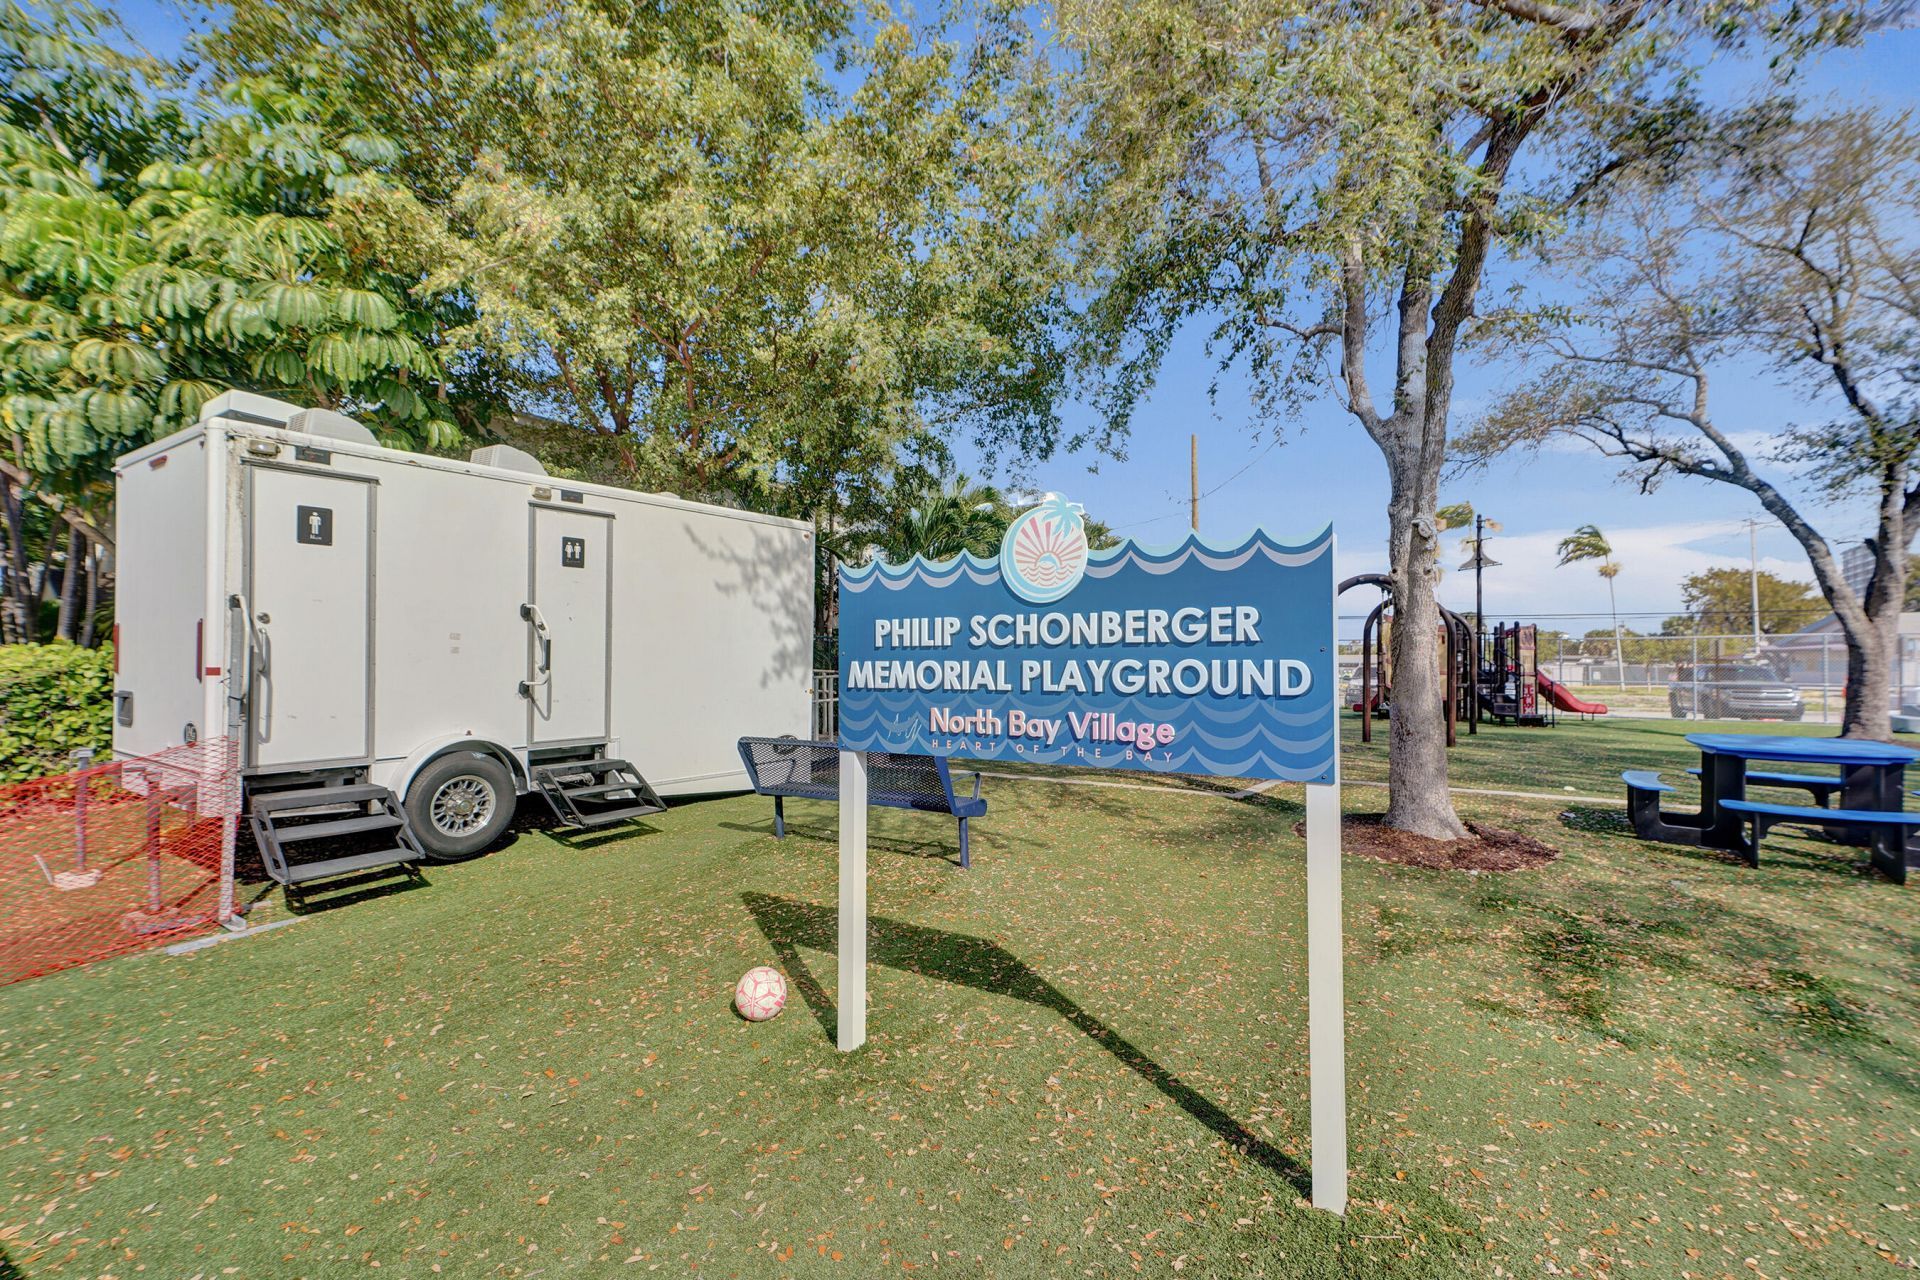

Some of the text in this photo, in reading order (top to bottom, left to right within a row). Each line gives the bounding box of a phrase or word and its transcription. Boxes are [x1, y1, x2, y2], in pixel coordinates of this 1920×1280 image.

[874, 606, 1261, 648] PHILIP SCHONBERGER
[847, 658, 1313, 696] MEMORIAL PLAYGROUND
[929, 707, 1001, 735] North
[1008, 710, 1062, 745] Bay
[1067, 711, 1176, 751] Village
[932, 739, 1173, 763] HEART OF THE BAY
